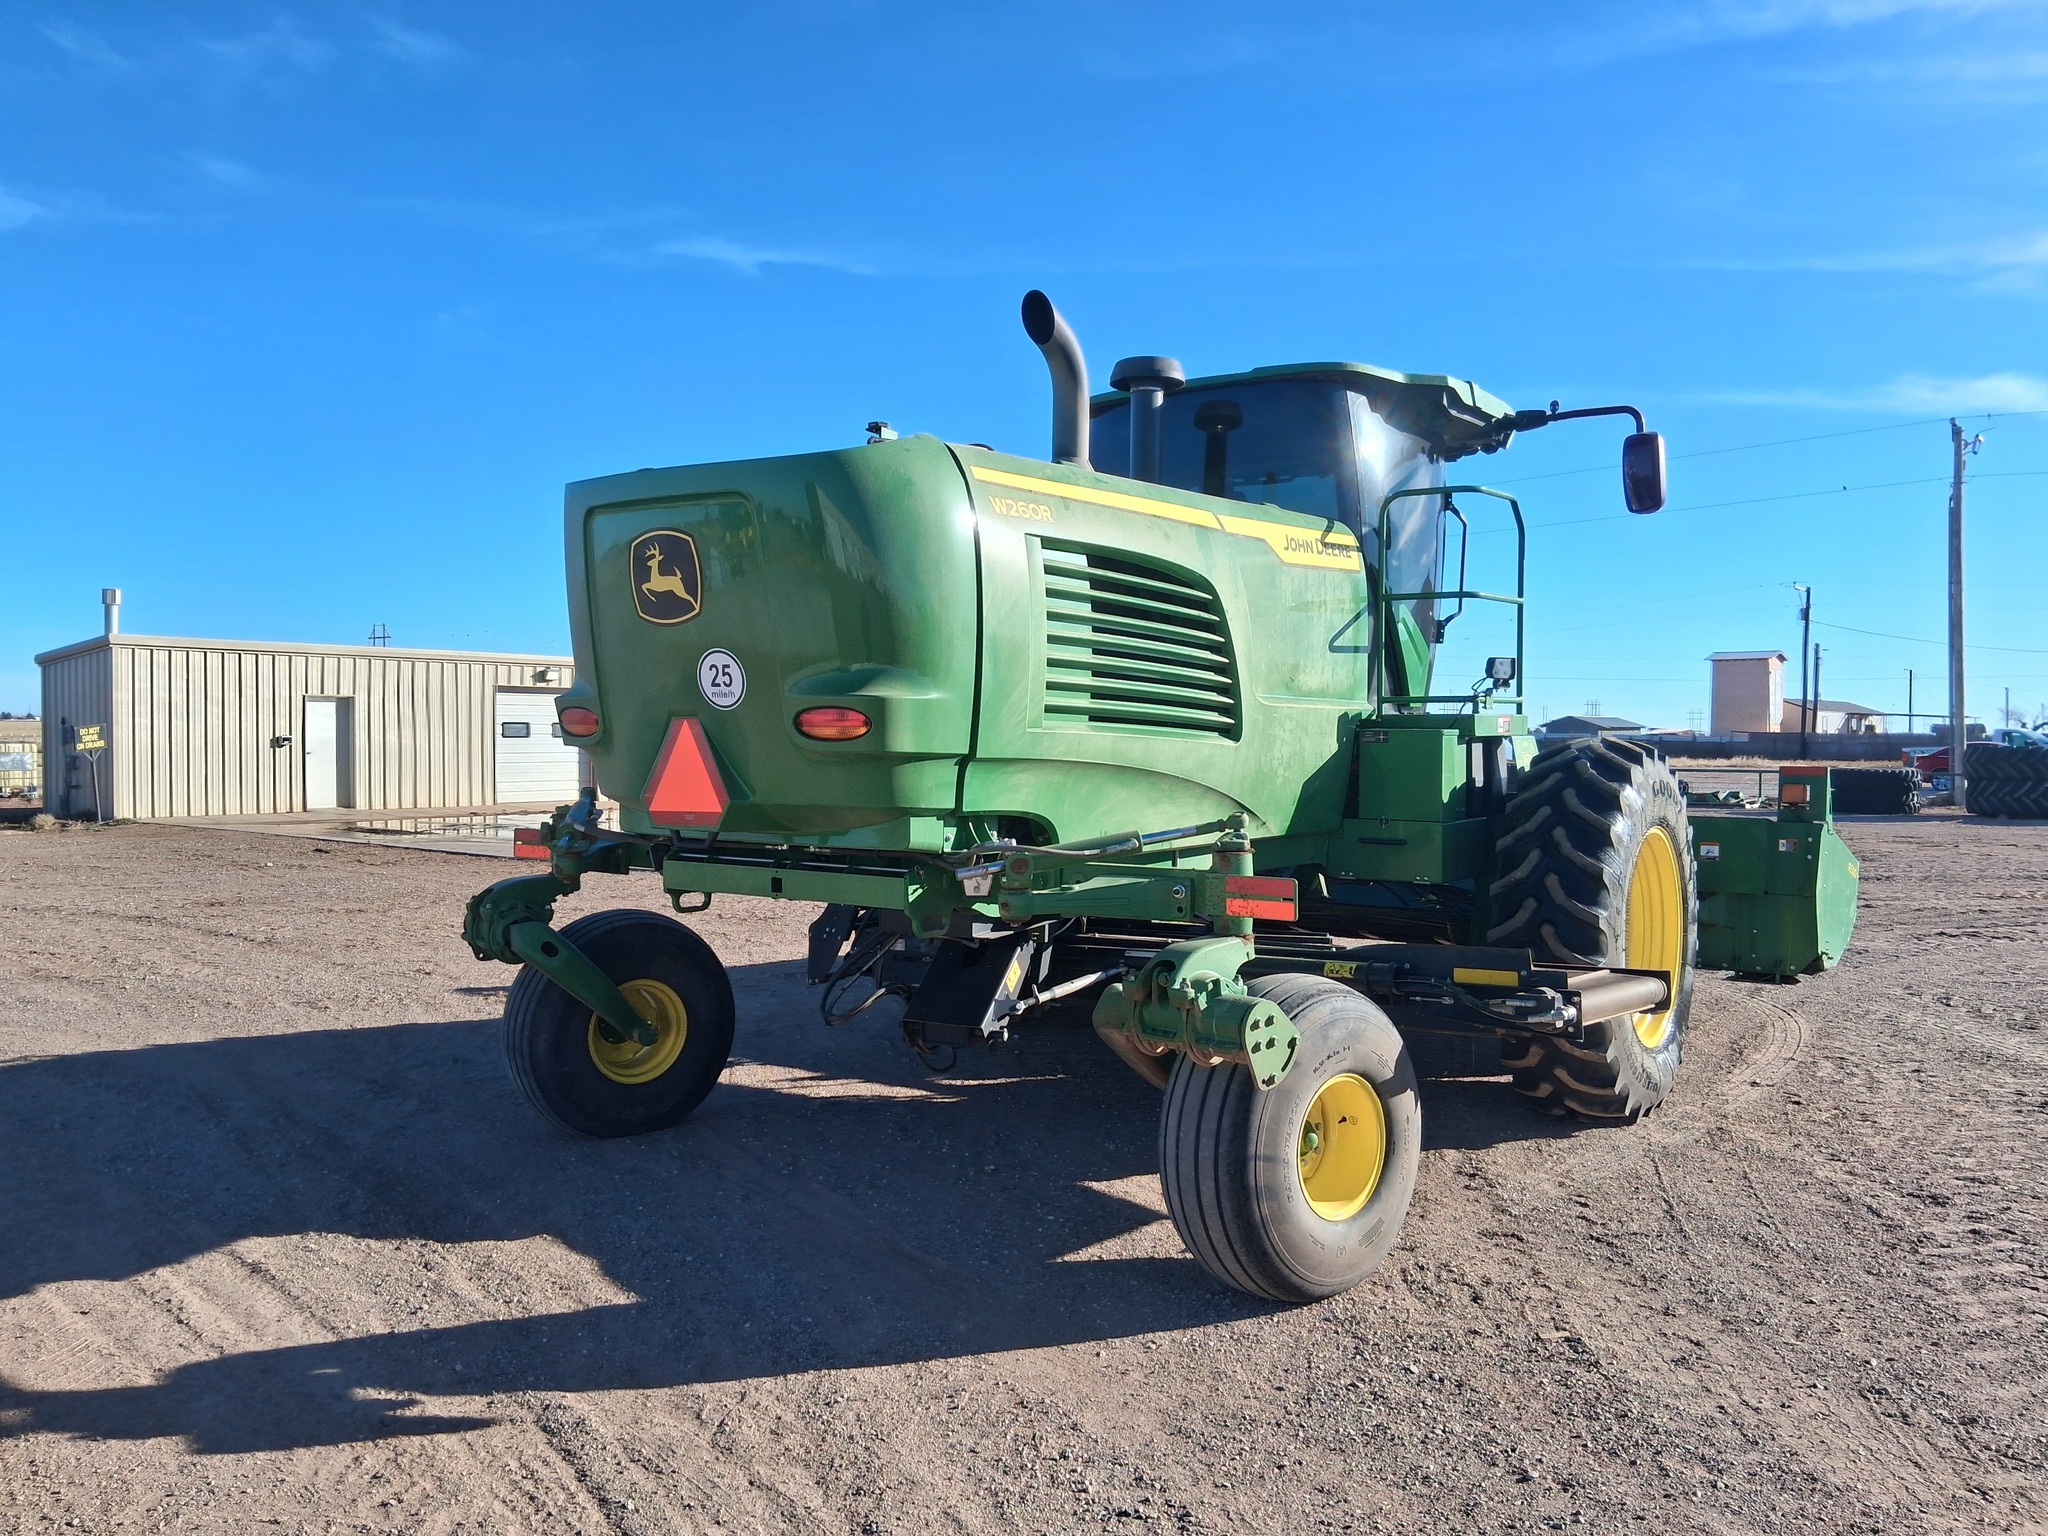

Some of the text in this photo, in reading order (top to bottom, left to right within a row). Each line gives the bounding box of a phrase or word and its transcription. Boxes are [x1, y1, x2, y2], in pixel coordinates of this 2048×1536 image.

[988, 495, 1056, 523] W260R
[1283, 534, 1352, 559] JOHN DEERE
[708, 663, 733, 688] 25
[711, 689, 736, 699] mile/h
[82, 734, 99, 742] DRIVE
[85, 740, 105, 748] DRAINS
